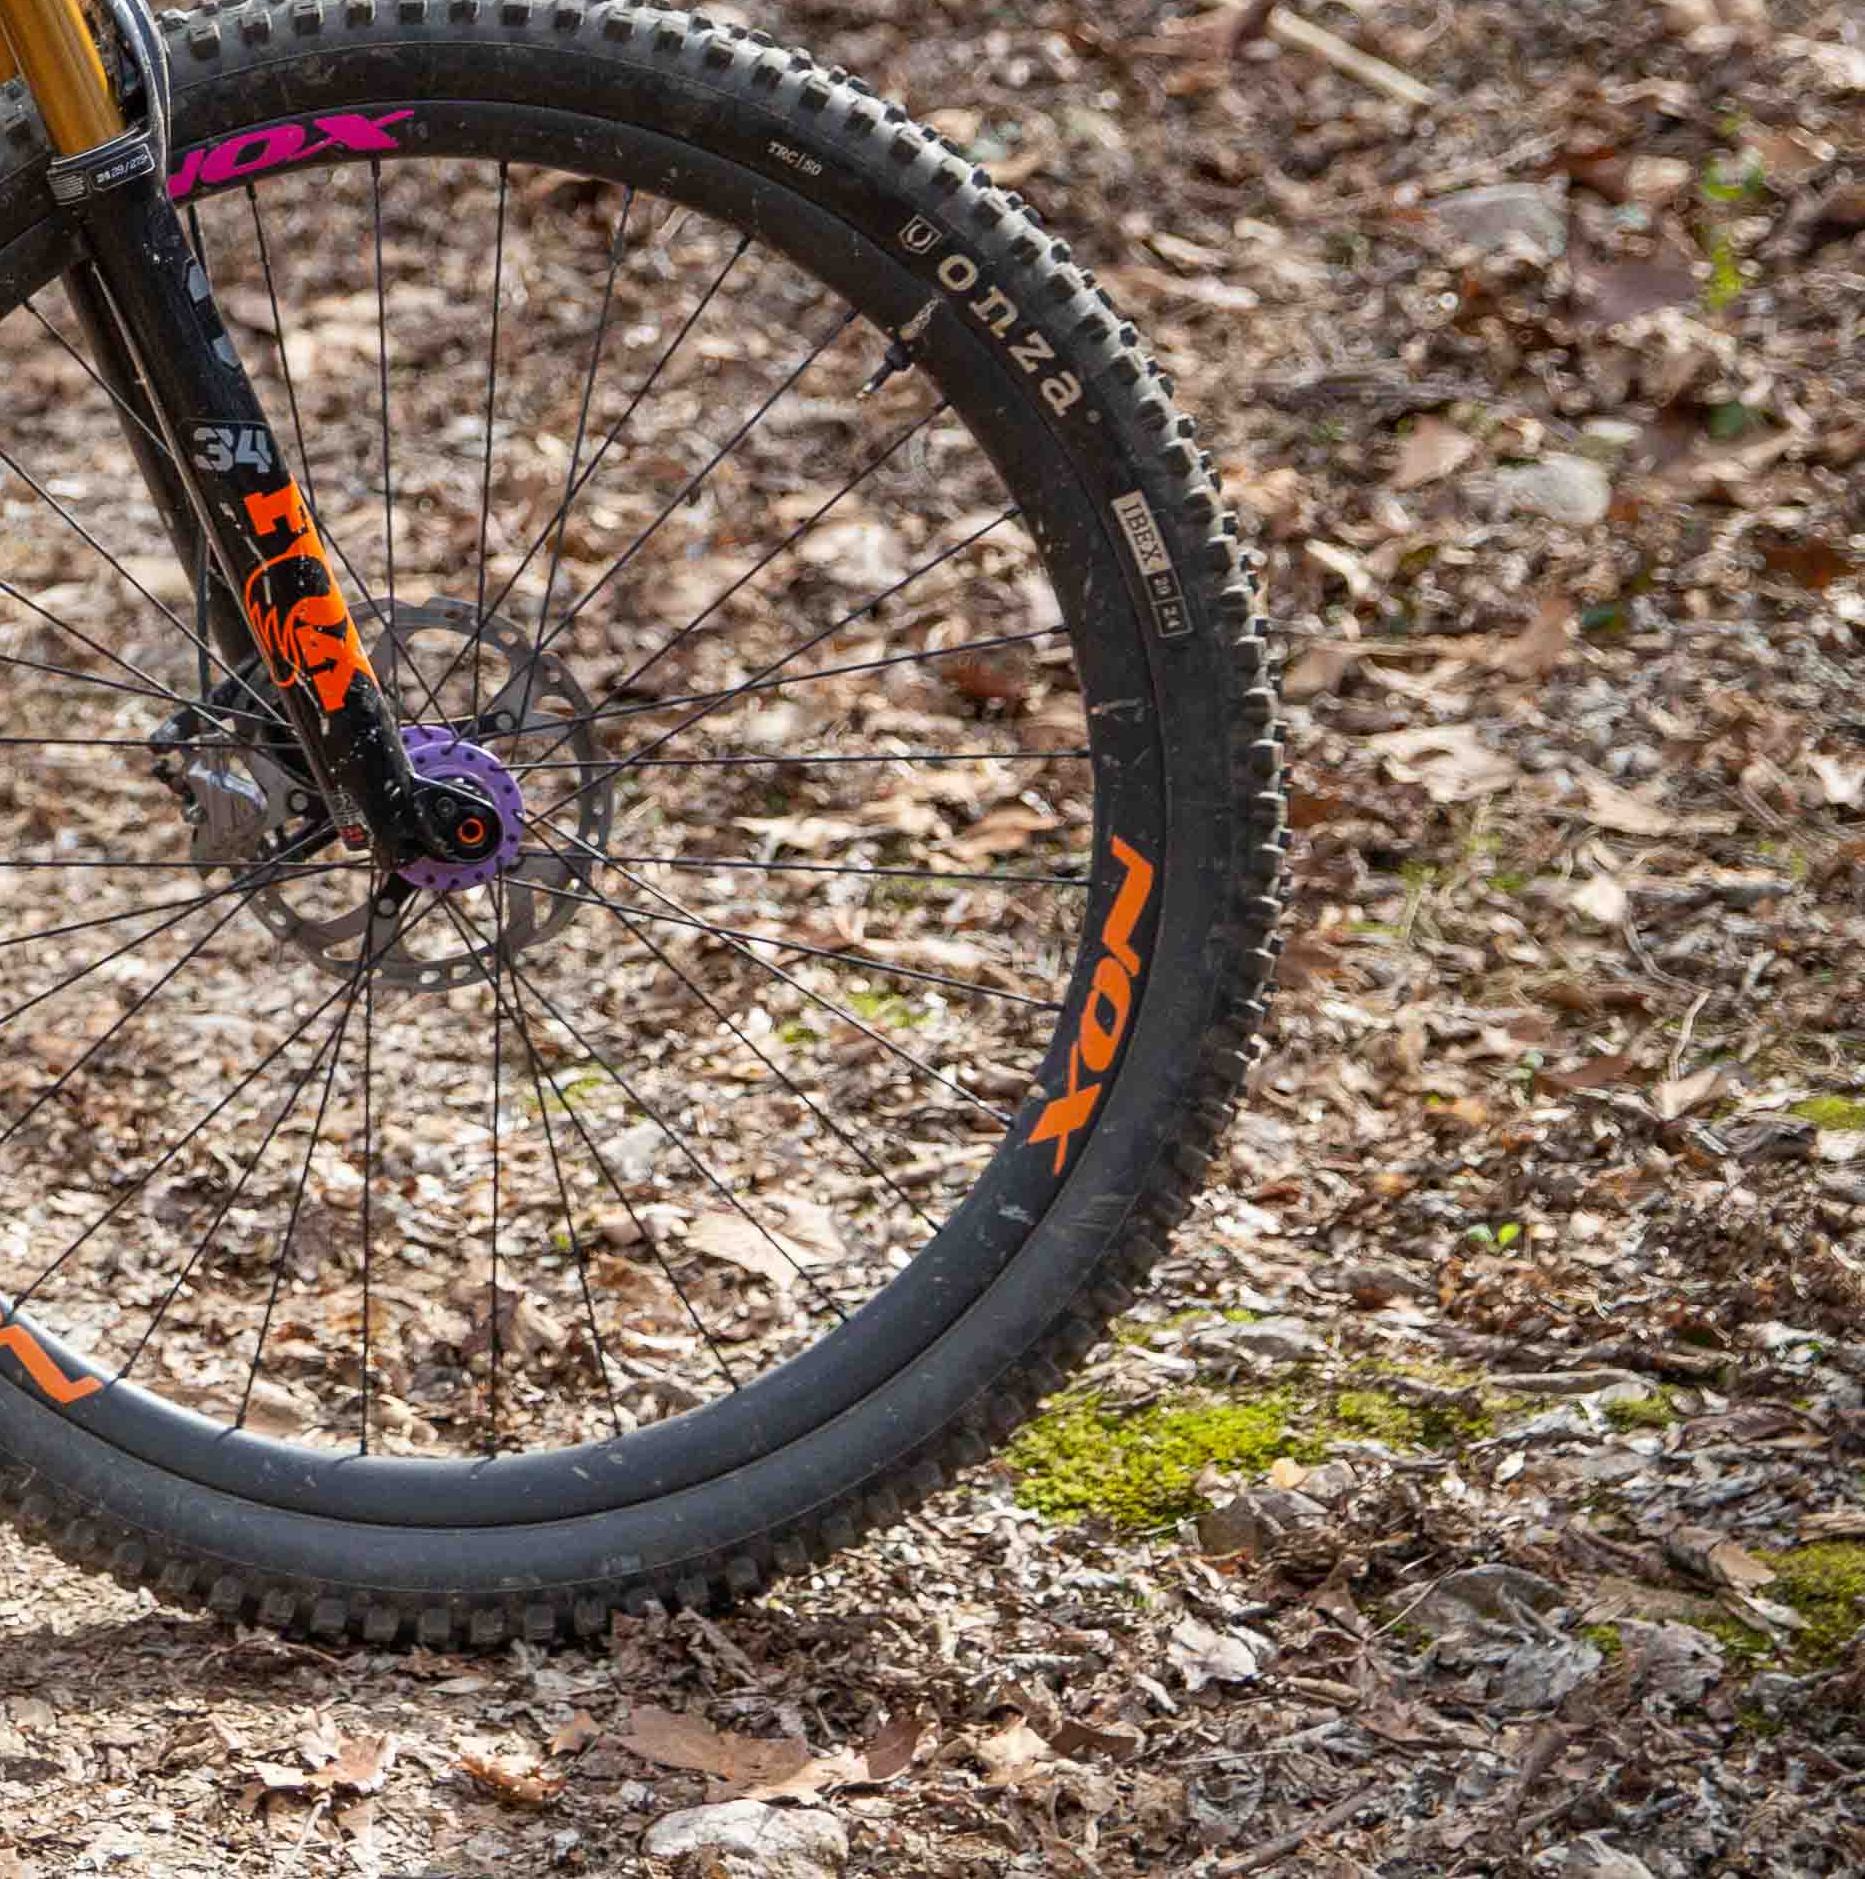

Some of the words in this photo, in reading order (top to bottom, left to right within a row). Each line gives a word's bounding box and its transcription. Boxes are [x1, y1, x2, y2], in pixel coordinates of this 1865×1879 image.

[937, 253, 1083, 418] onza
[194, 426, 272, 474] 34
[1122, 504, 1165, 565] IBEX
